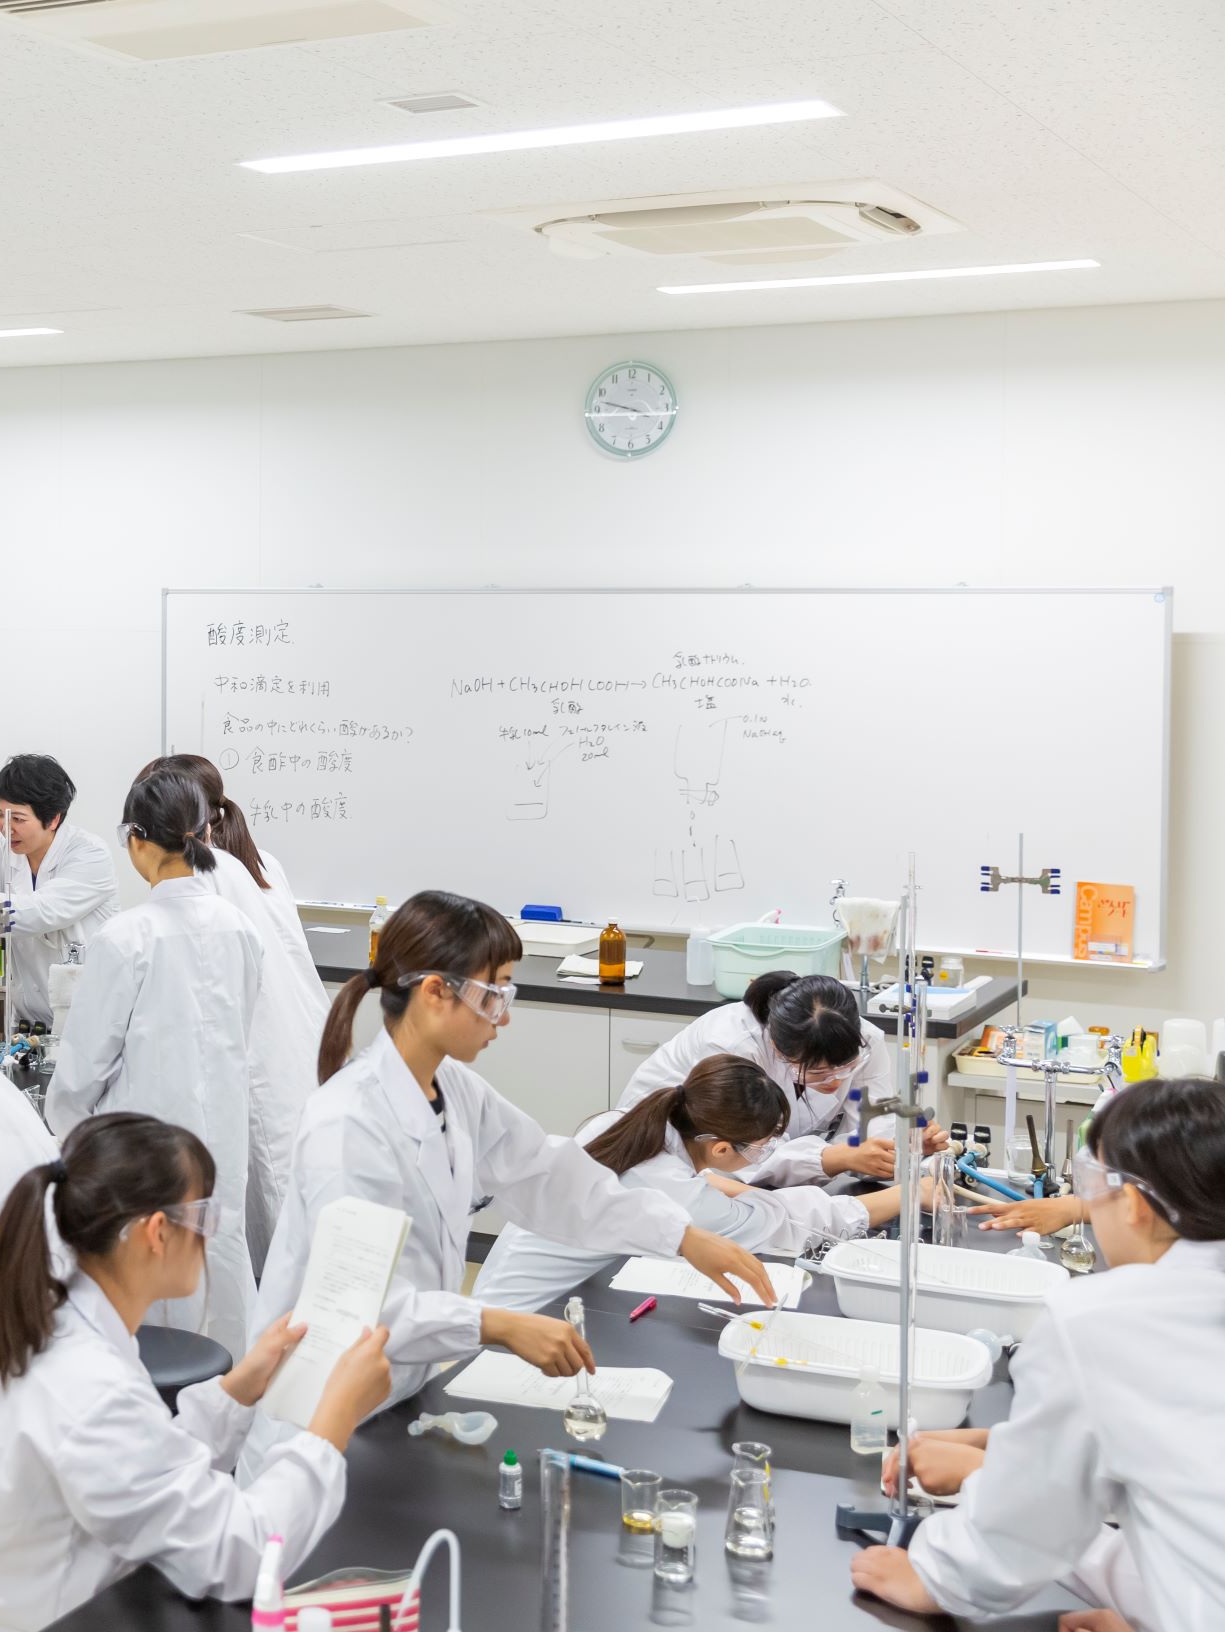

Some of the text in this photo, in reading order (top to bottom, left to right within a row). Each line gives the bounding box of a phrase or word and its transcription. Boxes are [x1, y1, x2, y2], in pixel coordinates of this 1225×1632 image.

[611, 374, 618, 384] 11
[628, 369, 637, 379] 12
[598, 388, 607, 398] 10
[207, 619, 290, 646] 酸度測定
[214, 674, 330, 697] 中和滴定を利用
[250, 792, 348, 826] 牛乳中の酸度
